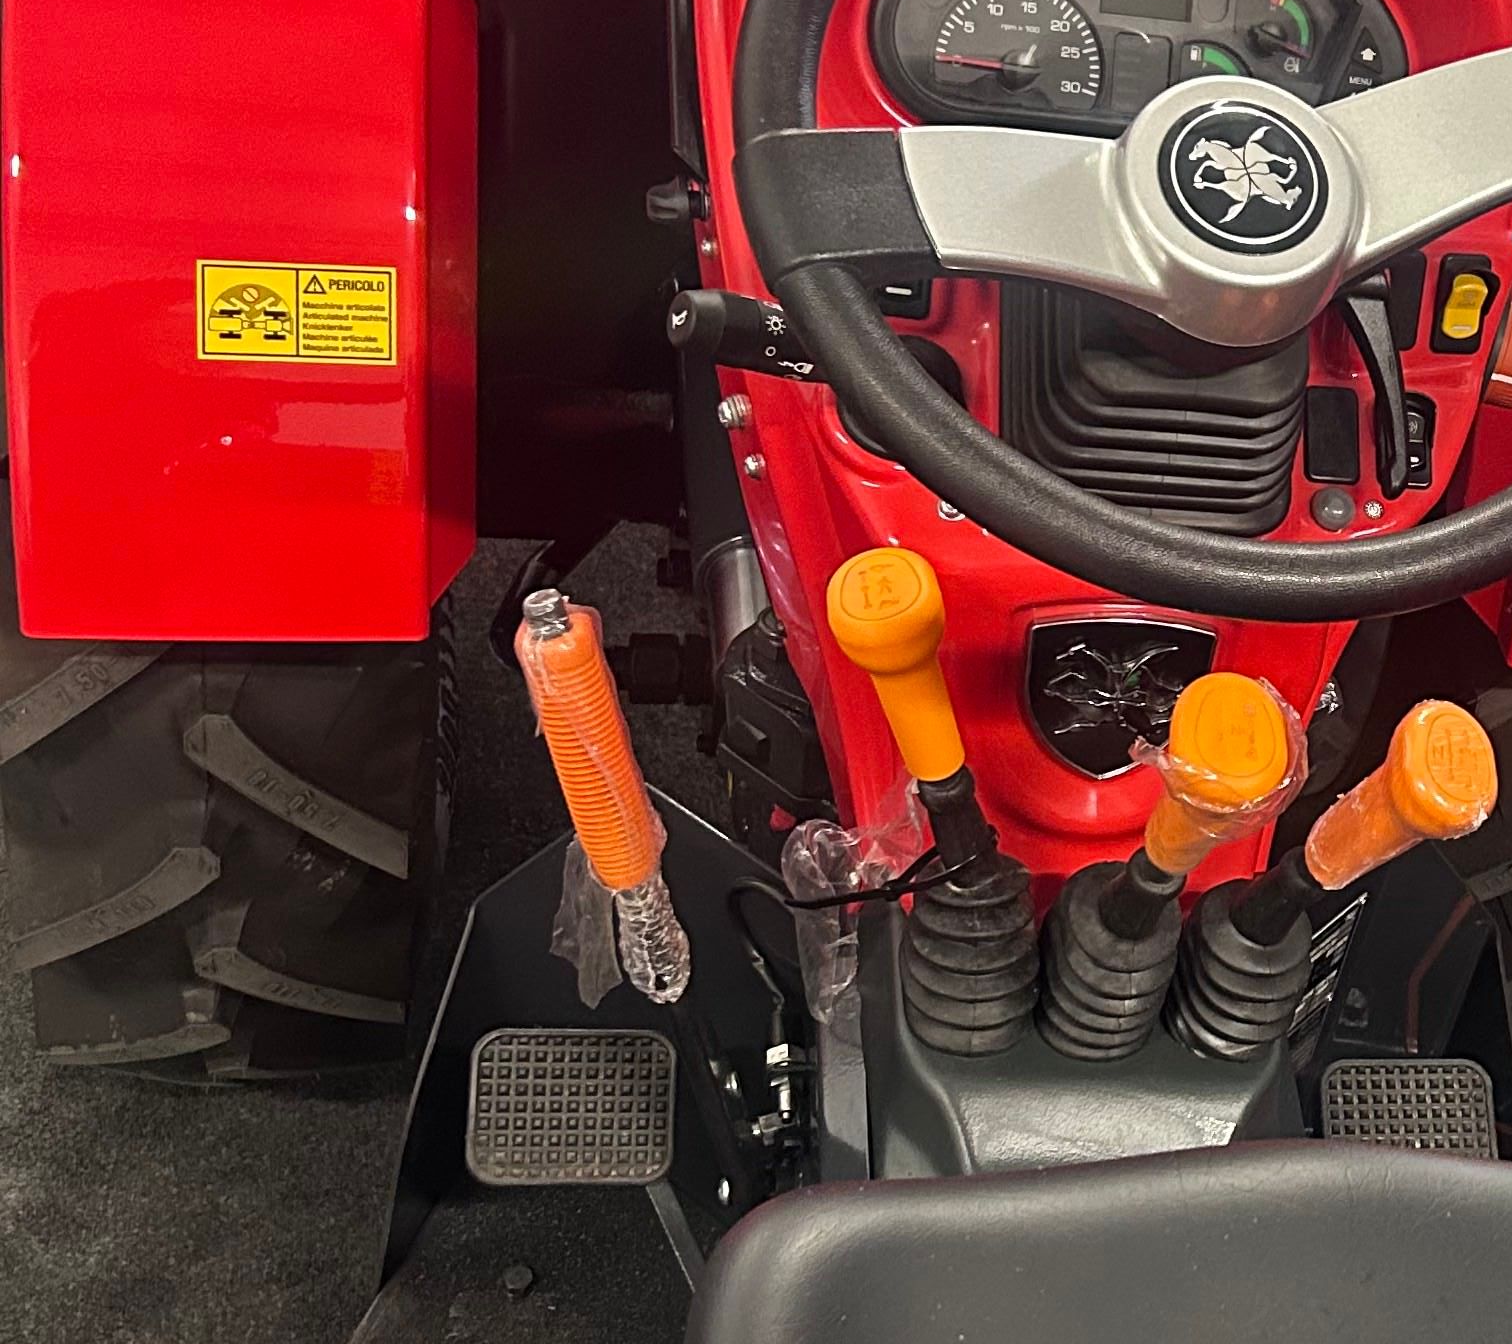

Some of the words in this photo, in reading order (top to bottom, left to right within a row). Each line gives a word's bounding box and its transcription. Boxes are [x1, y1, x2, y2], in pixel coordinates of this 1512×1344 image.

[987, 4, 1004, 16] 10
[1021, 2, 1038, 14] 15
[964, 21, 975, 33] 5
[1001, 23, 1017, 31] rpm
[1025, 25, 1040, 34] 100
[1050, 20, 1070, 33] 20
[1060, 46, 1081, 59] 25
[1060, 80, 1081, 94] 30
[1349, 76, 1373, 86] MENU
[328, 278, 385, 292] PERICOLO
